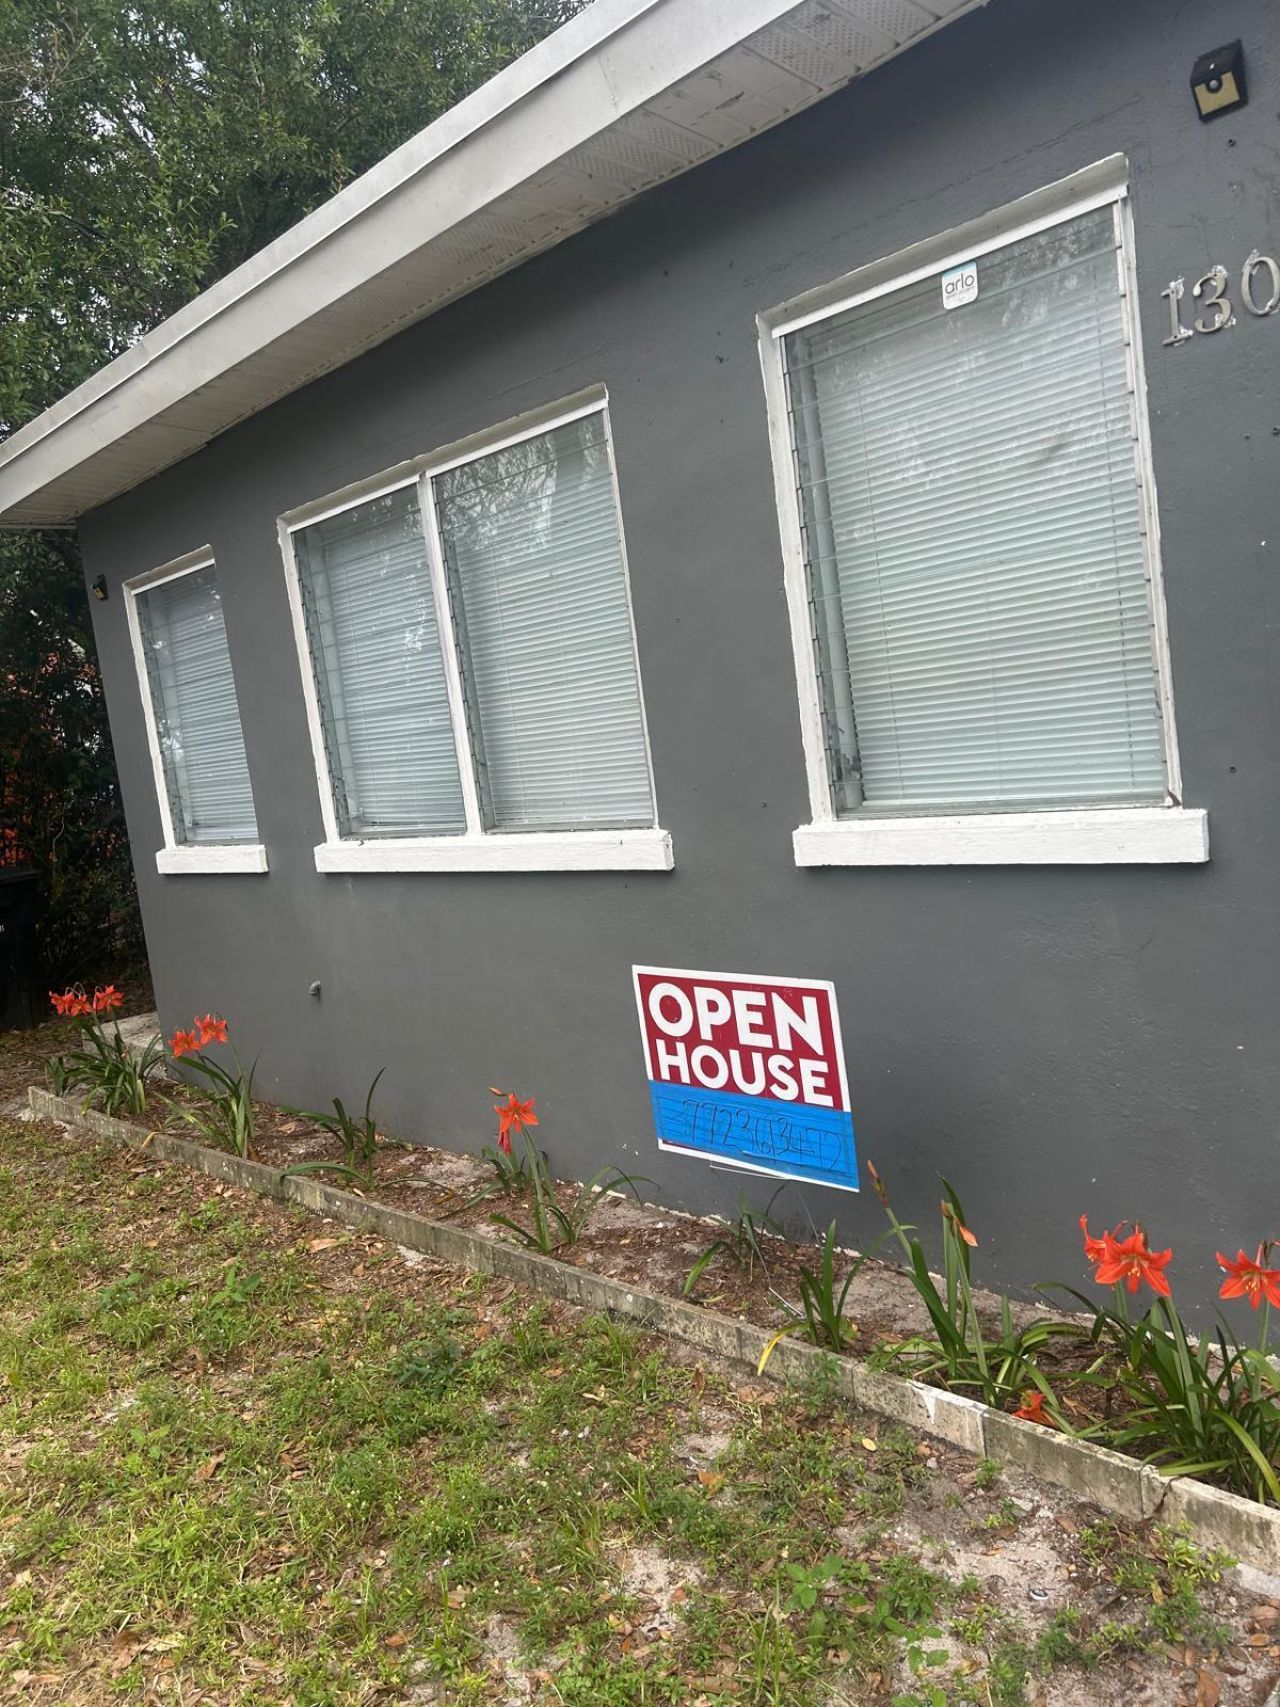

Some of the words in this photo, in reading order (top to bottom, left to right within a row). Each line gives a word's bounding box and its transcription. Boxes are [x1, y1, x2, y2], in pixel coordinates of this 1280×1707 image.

[945, 272, 975, 295] arlo
[1160, 256, 1280, 346] 130
[648, 982, 824, 1056] OPEN
[655, 1038, 834, 1108] HOUSE
